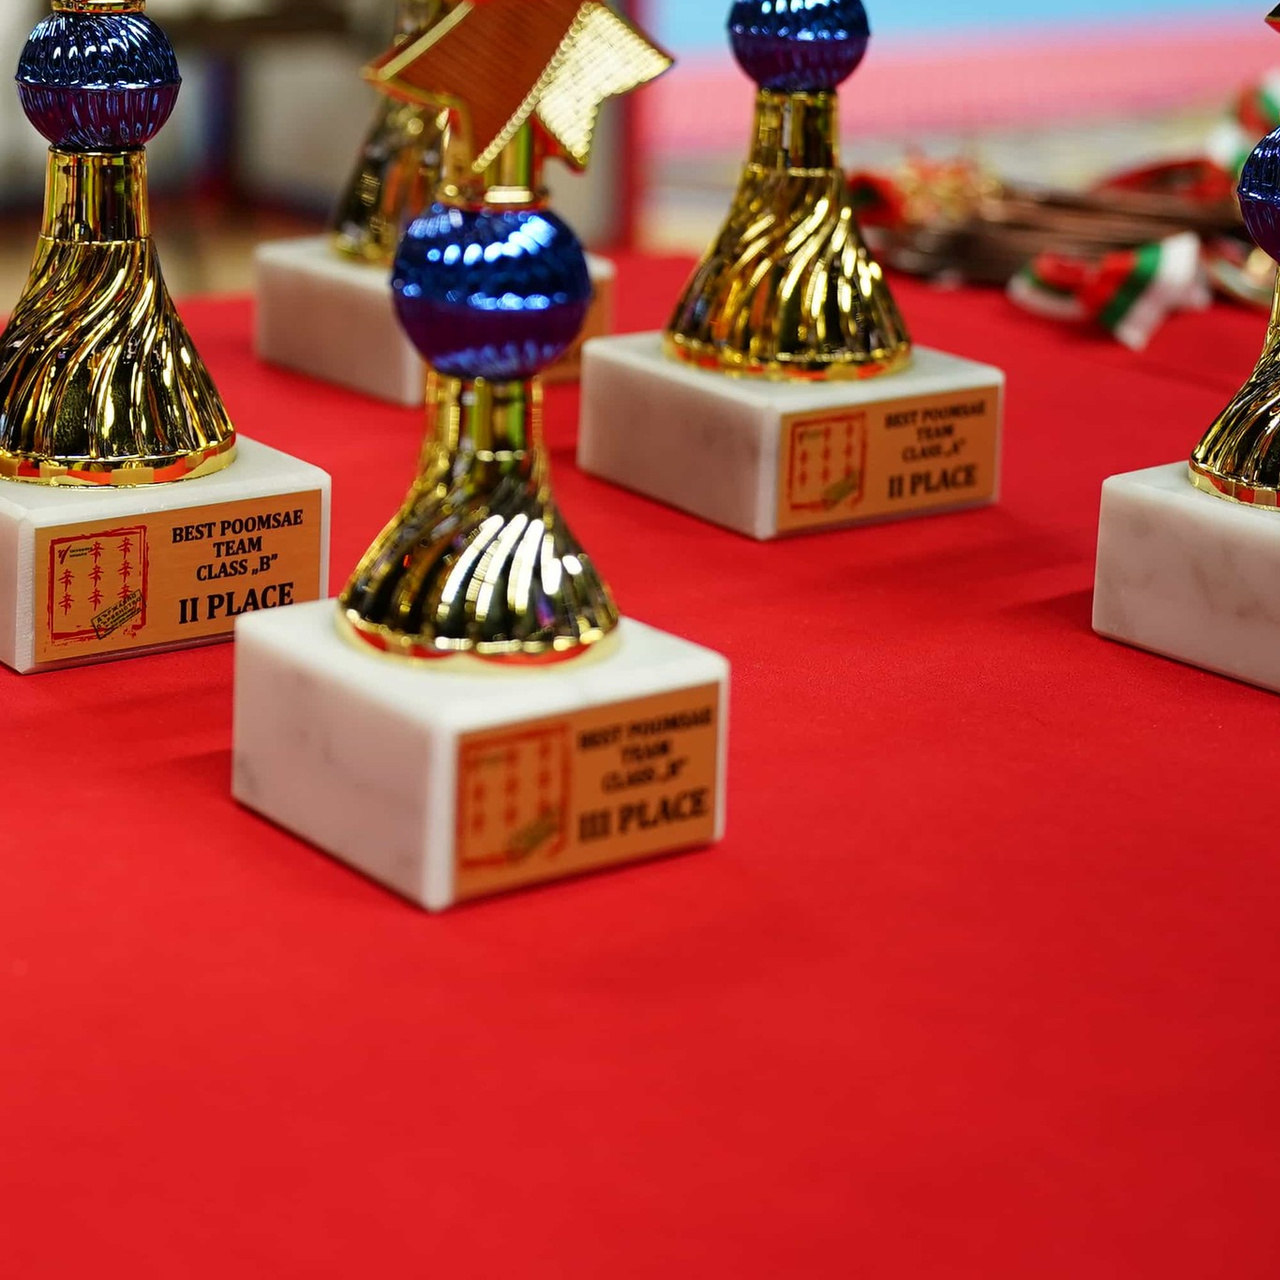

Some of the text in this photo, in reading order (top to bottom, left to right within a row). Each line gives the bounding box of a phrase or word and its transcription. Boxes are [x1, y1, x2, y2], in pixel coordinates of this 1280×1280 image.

[885, 401, 985, 429] BEST POOMSAE
[917, 424, 954, 442] TEAM
[901, 445, 942, 462] CLASS
[888, 475, 904, 499] II
[910, 463, 977, 496] PLACE
[172, 509, 303, 543] BEST POOMSAE
[213, 536, 262, 558] TEAM
[196, 559, 248, 581] CLASS
[179, 597, 199, 624] II
[207, 582, 294, 620] PLACE
[578, 707, 712, 751] BEST POOMSAE
[621, 740, 670, 762] TEAM
[601, 768, 656, 793] CLASS
[579, 810, 612, 841] III
[618, 787, 708, 834] PLACE
